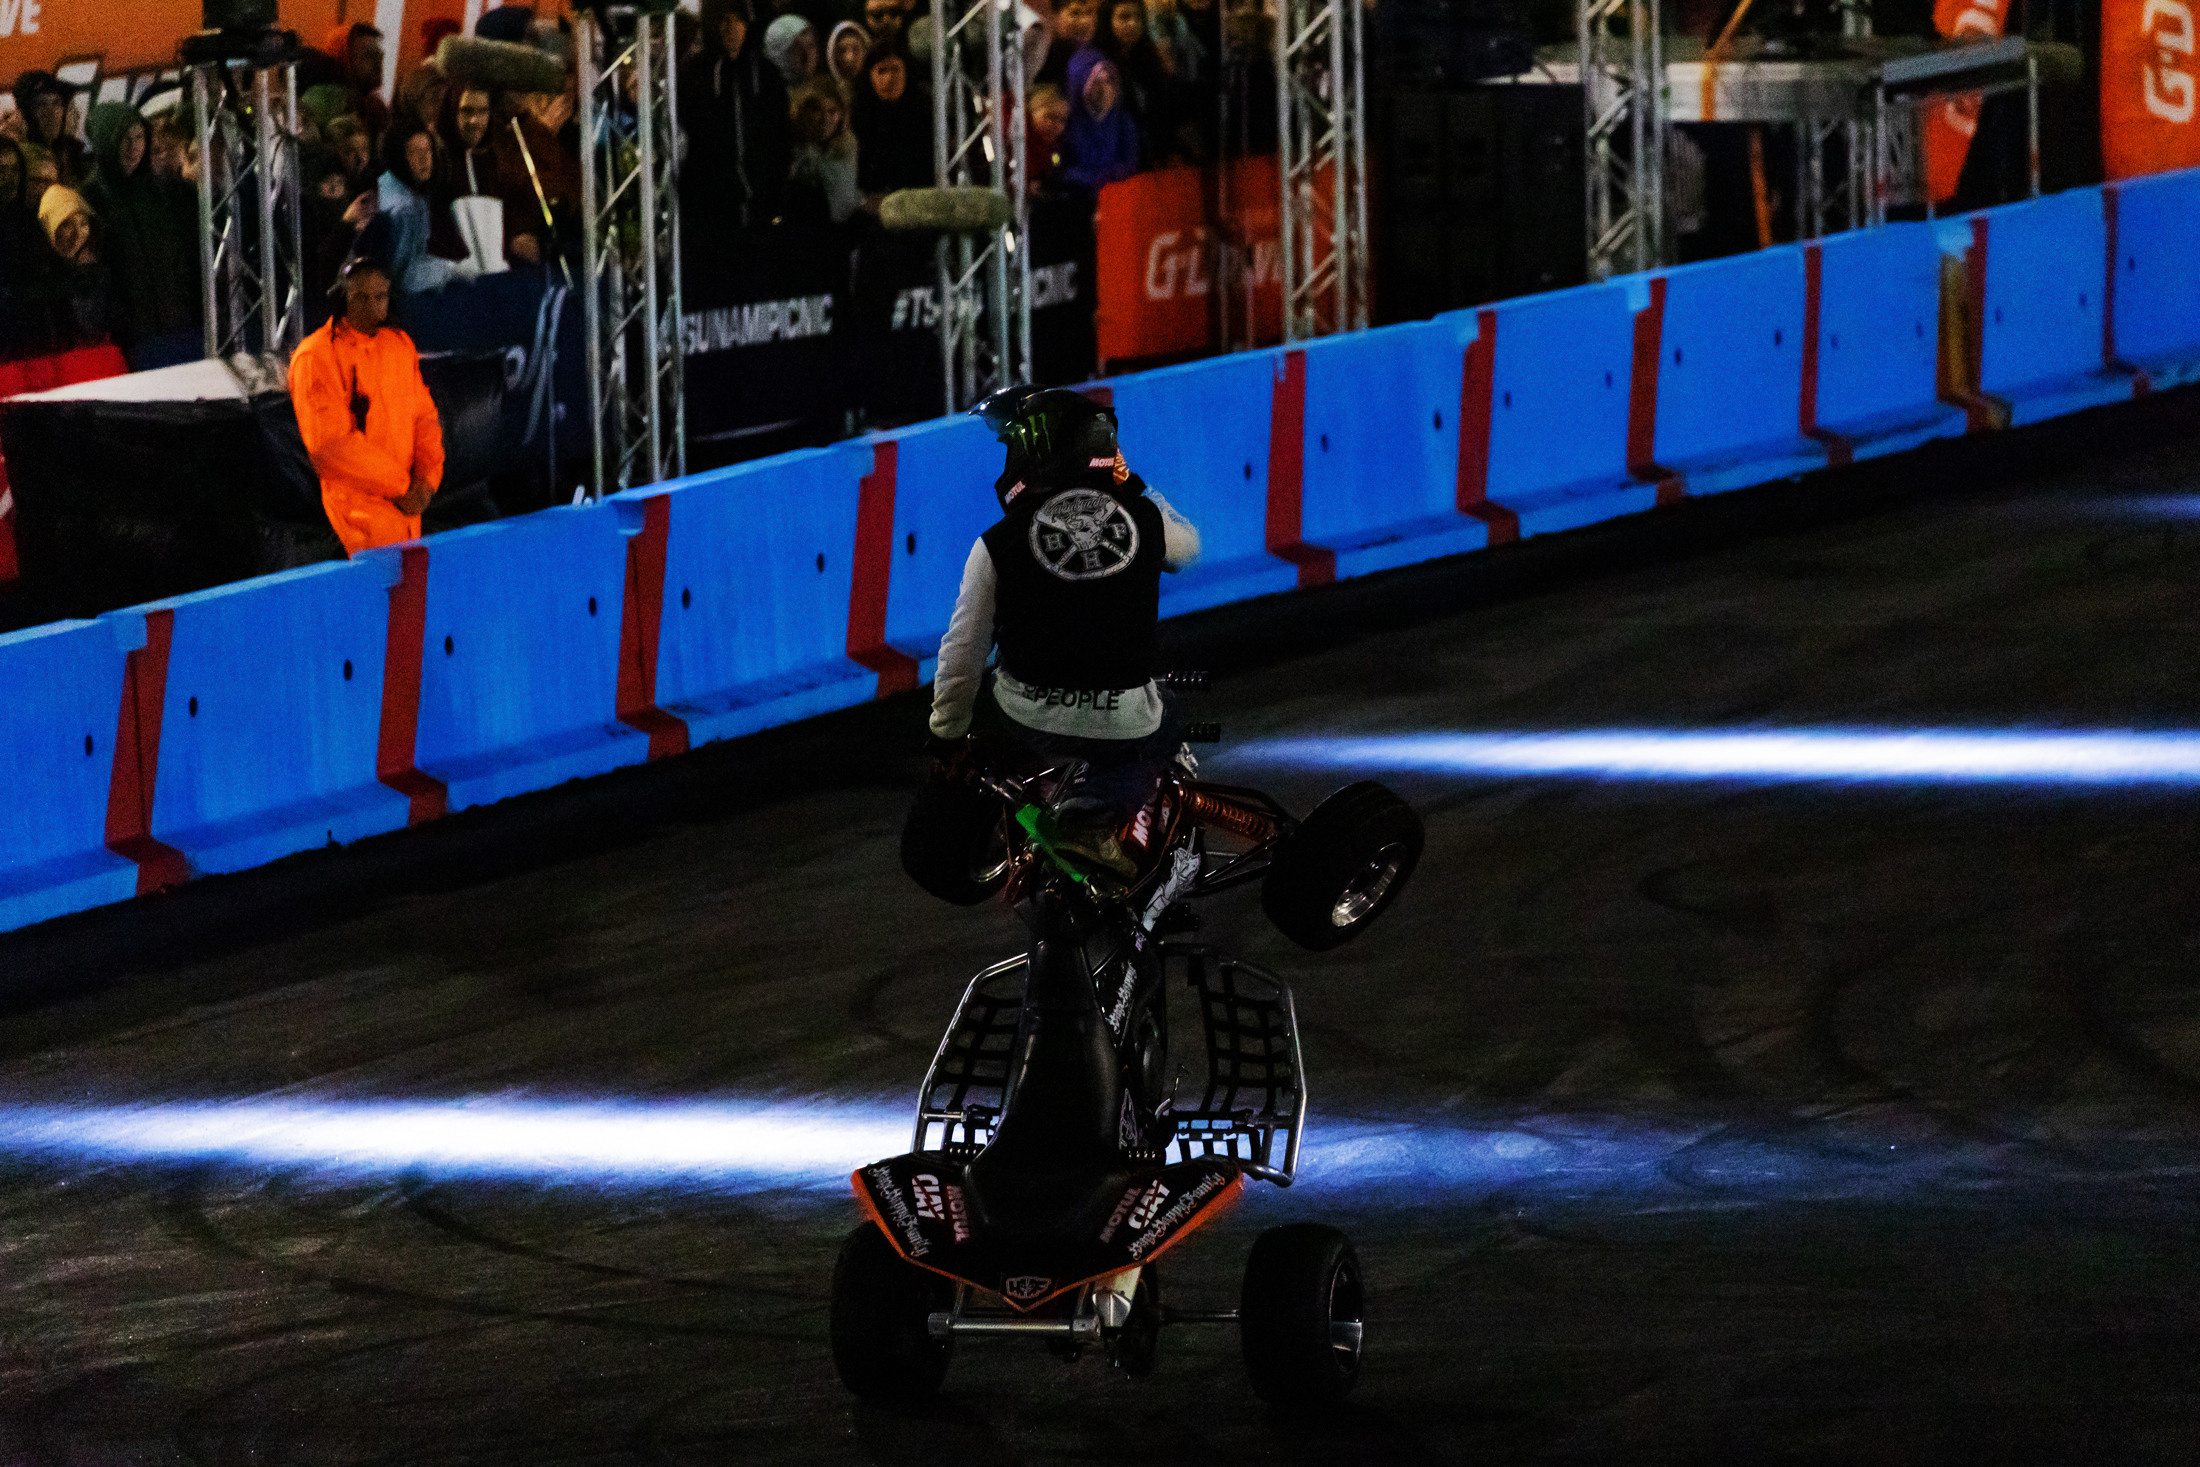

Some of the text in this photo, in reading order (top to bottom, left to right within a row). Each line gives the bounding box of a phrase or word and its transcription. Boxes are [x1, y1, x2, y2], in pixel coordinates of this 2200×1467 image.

[1034, 686, 1121, 710] PEOPLE
[946, 1185, 970, 1243] MOTUL
[1100, 1187, 1142, 1244] MOTUL
